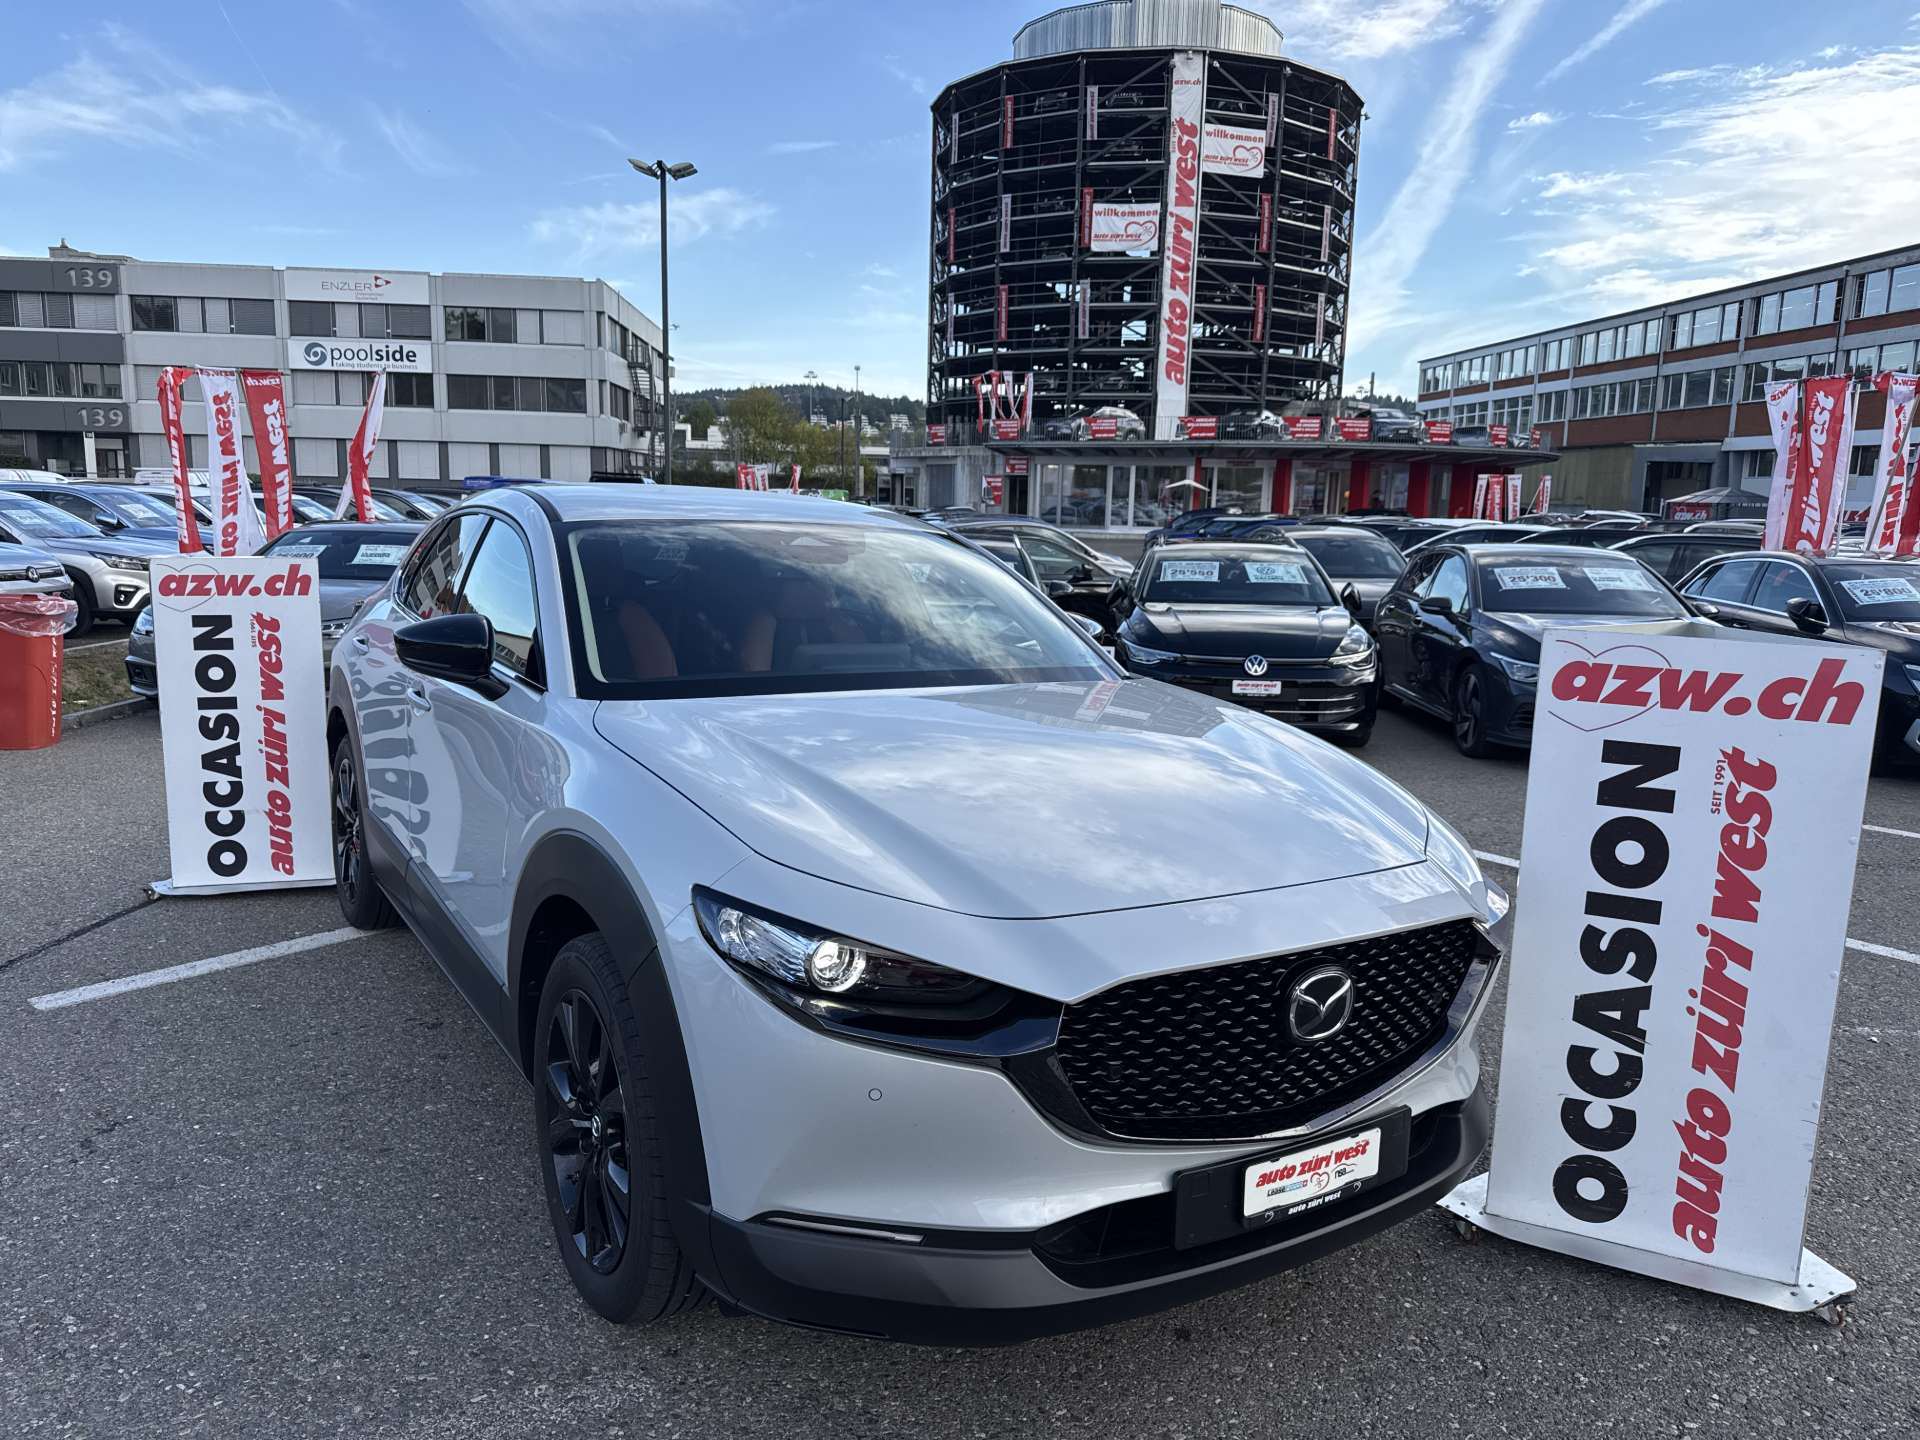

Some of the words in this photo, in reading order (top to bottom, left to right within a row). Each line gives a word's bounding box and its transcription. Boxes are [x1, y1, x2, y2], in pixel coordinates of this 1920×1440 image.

[1174, 78, 1201, 86] azw.ch
[1205, 128, 1264, 143] willkommen
[1174, 117, 1199, 207] west
[1094, 207, 1159, 218] willkommen
[64, 267, 113, 288] 139
[1166, 211, 1195, 298] züri
[321, 280, 372, 292] ENZLER
[330, 343, 417, 367] poolside
[335, 361, 355, 370] taking
[356, 362, 382, 370] students
[1163, 297, 1189, 386] auto
[77, 408, 124, 428] 139
[158, 564, 312, 597] azw.ch
[256, 611, 286, 701] west
[1550, 656, 1866, 726] azw.ch
[191, 614, 248, 877] OCCASION
[255, 704, 290, 789] züri
[1712, 757, 1727, 783] 1991
[1710, 785, 1723, 815] SEIT
[264, 789, 295, 877] auto
[1710, 745, 1778, 924] west
[1552, 738, 1682, 1224] OCCASION
[1685, 922, 1756, 1094] züri
[1255, 1164, 1297, 1188] auto
[1297, 1151, 1334, 1177] züri
[1333, 1138, 1371, 1164] west
[1669, 1090, 1734, 1255] auto
[1288, 1204, 1307, 1215] auto
[1324, 1190, 1342, 1204] west
